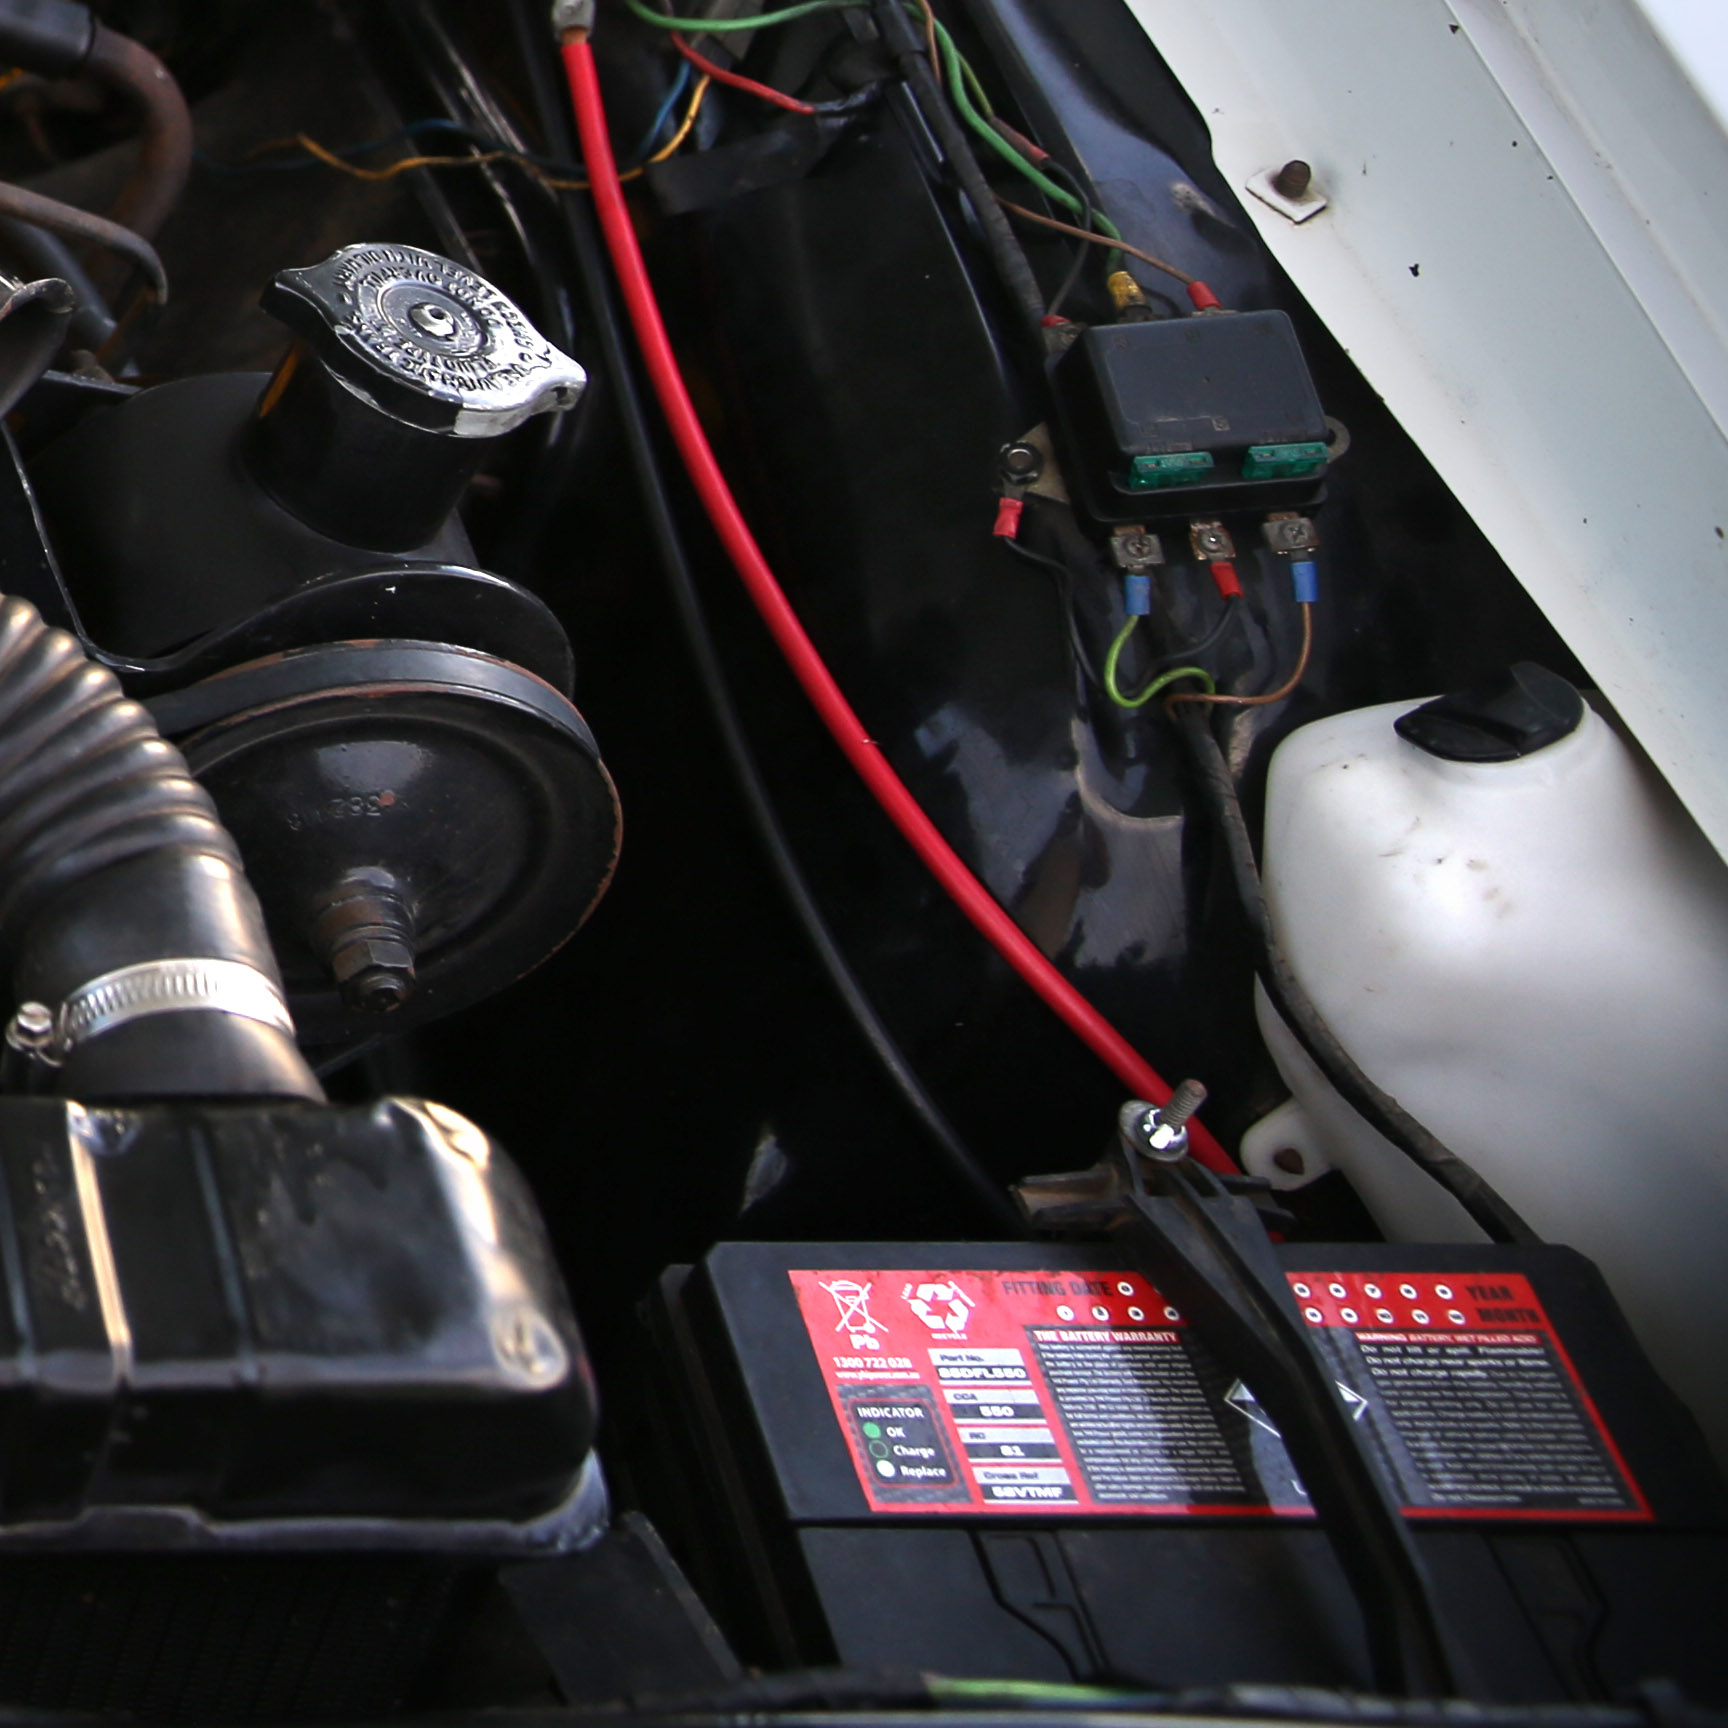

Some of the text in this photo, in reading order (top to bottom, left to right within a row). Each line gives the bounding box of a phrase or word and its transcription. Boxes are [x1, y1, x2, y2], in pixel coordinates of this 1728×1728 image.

[1002, 1281, 1114, 1296] FITTING DATE
[1465, 1285, 1514, 1301] YEAR
[1476, 1308, 1541, 1323] MONTH
[849, 1334, 880, 1350] Pb
[1033, 1330, 1178, 1342] THE BATTERY WARRANTY
[1360, 1345, 1378, 1354] Do
[1382, 1345, 1402, 1354] not
[833, 1357, 864, 1368] 1300
[863, 1357, 889, 1368] 722
[939, 1354, 964, 1362] Part
[1366, 1356, 1382, 1365] Do
[1383, 1356, 1402, 1365] not
[1371, 1367, 1388, 1376] Do
[1389, 1368, 1409, 1376] not
[857, 1407, 925, 1418] INDICATOR
[978, 1405, 1015, 1417] 550
[886, 1426, 906, 1438] OK
[893, 1444, 935, 1459] Charge
[900, 1465, 947, 1478] Replace
[983, 1471, 1018, 1480] Cross
